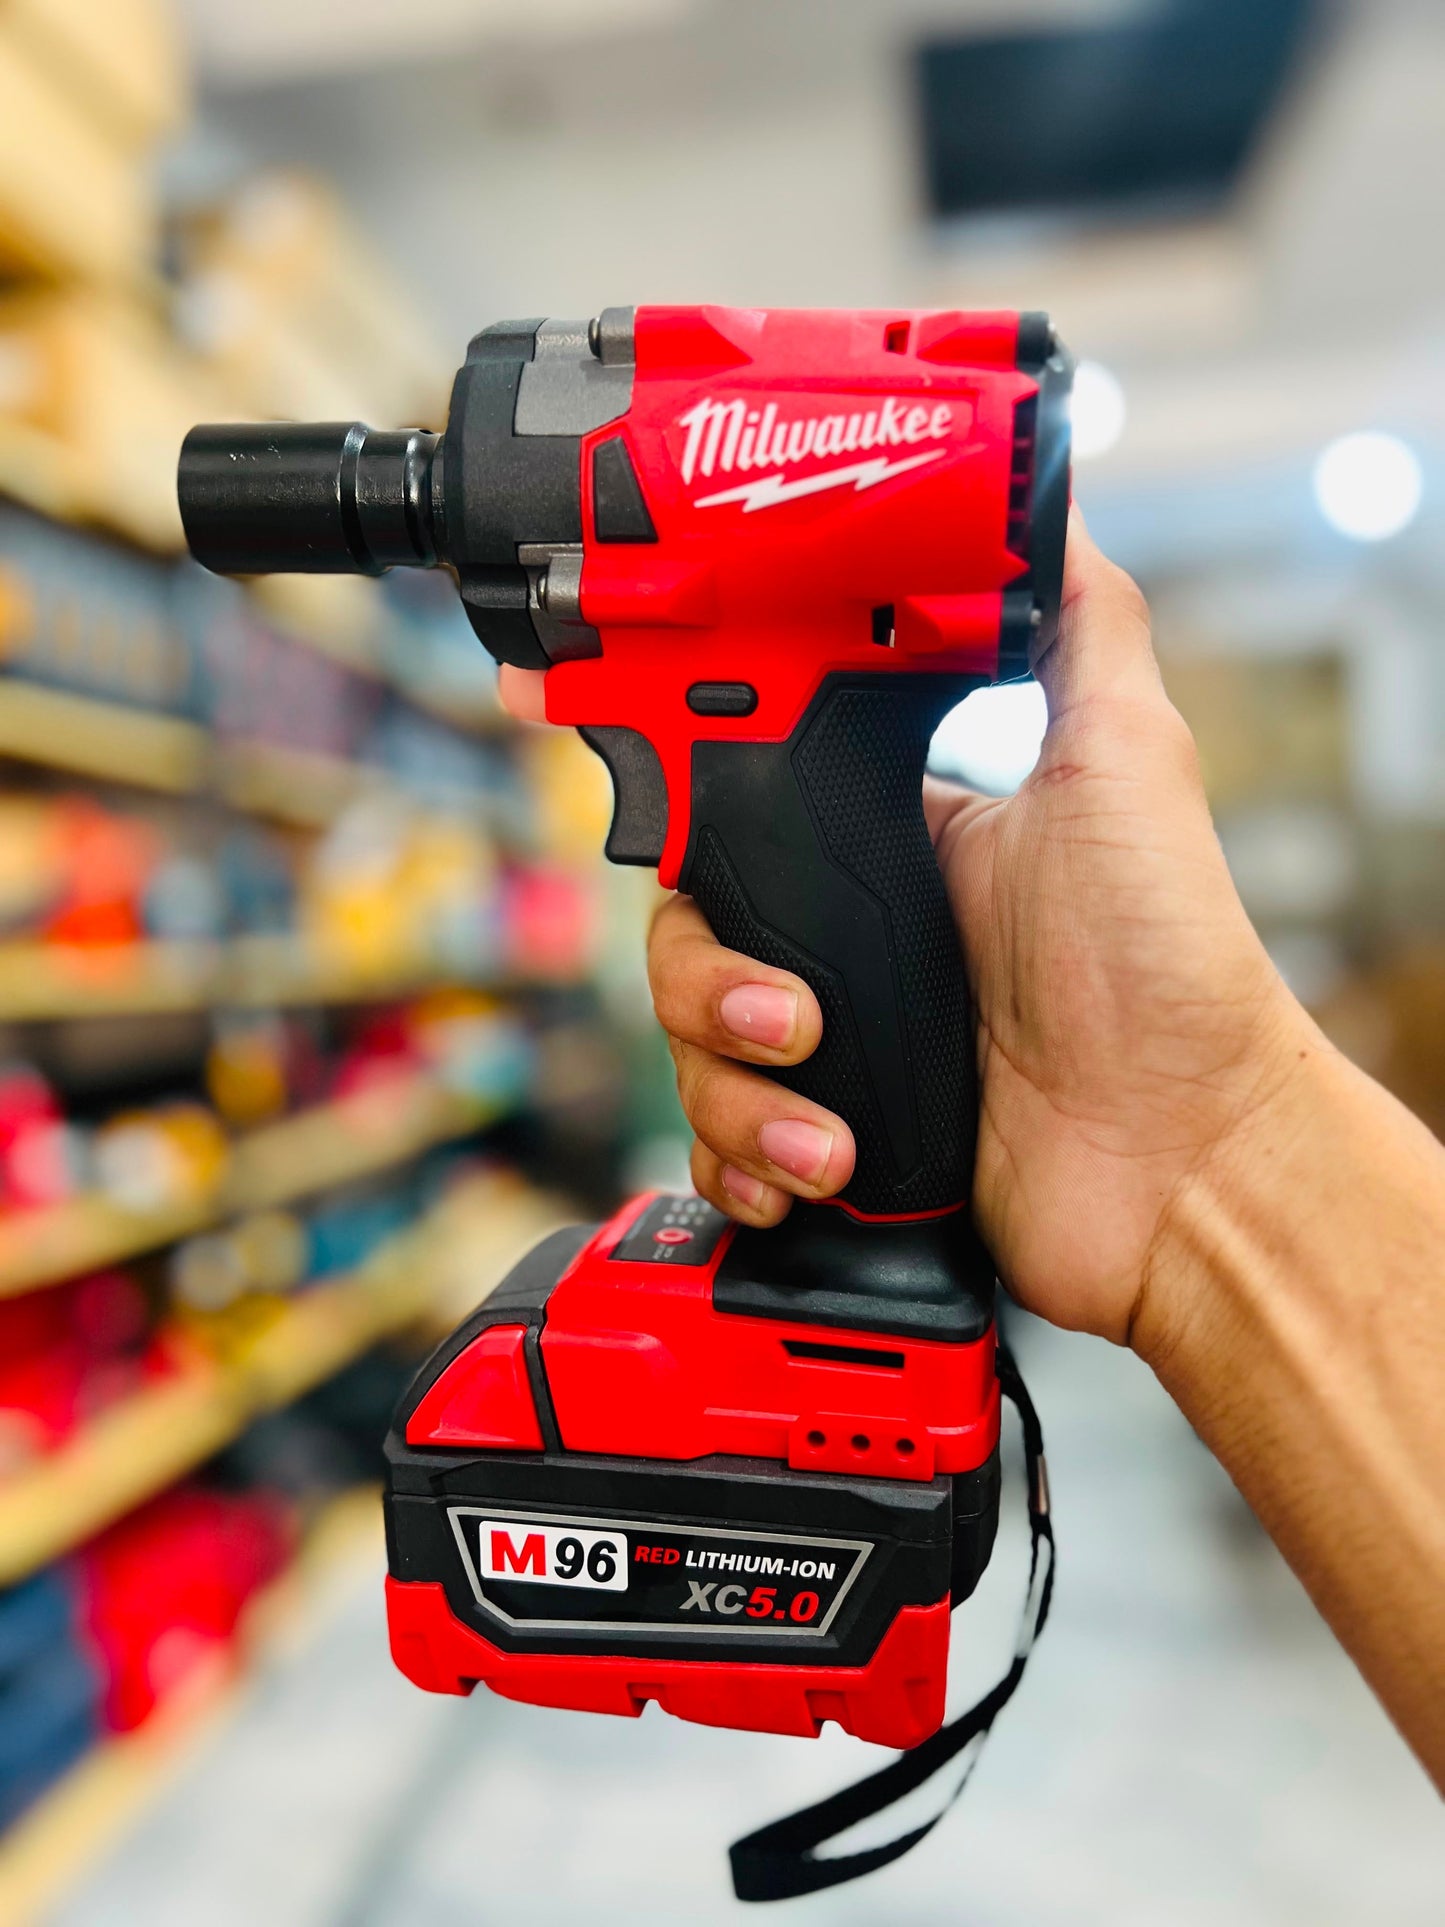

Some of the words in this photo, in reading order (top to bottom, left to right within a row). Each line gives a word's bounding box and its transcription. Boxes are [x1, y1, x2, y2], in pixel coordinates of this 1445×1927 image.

[680, 397, 952, 486] Milwaukee
[634, 1545, 681, 1565] RED
[685, 1550, 836, 1580] LITHIUM-ION
